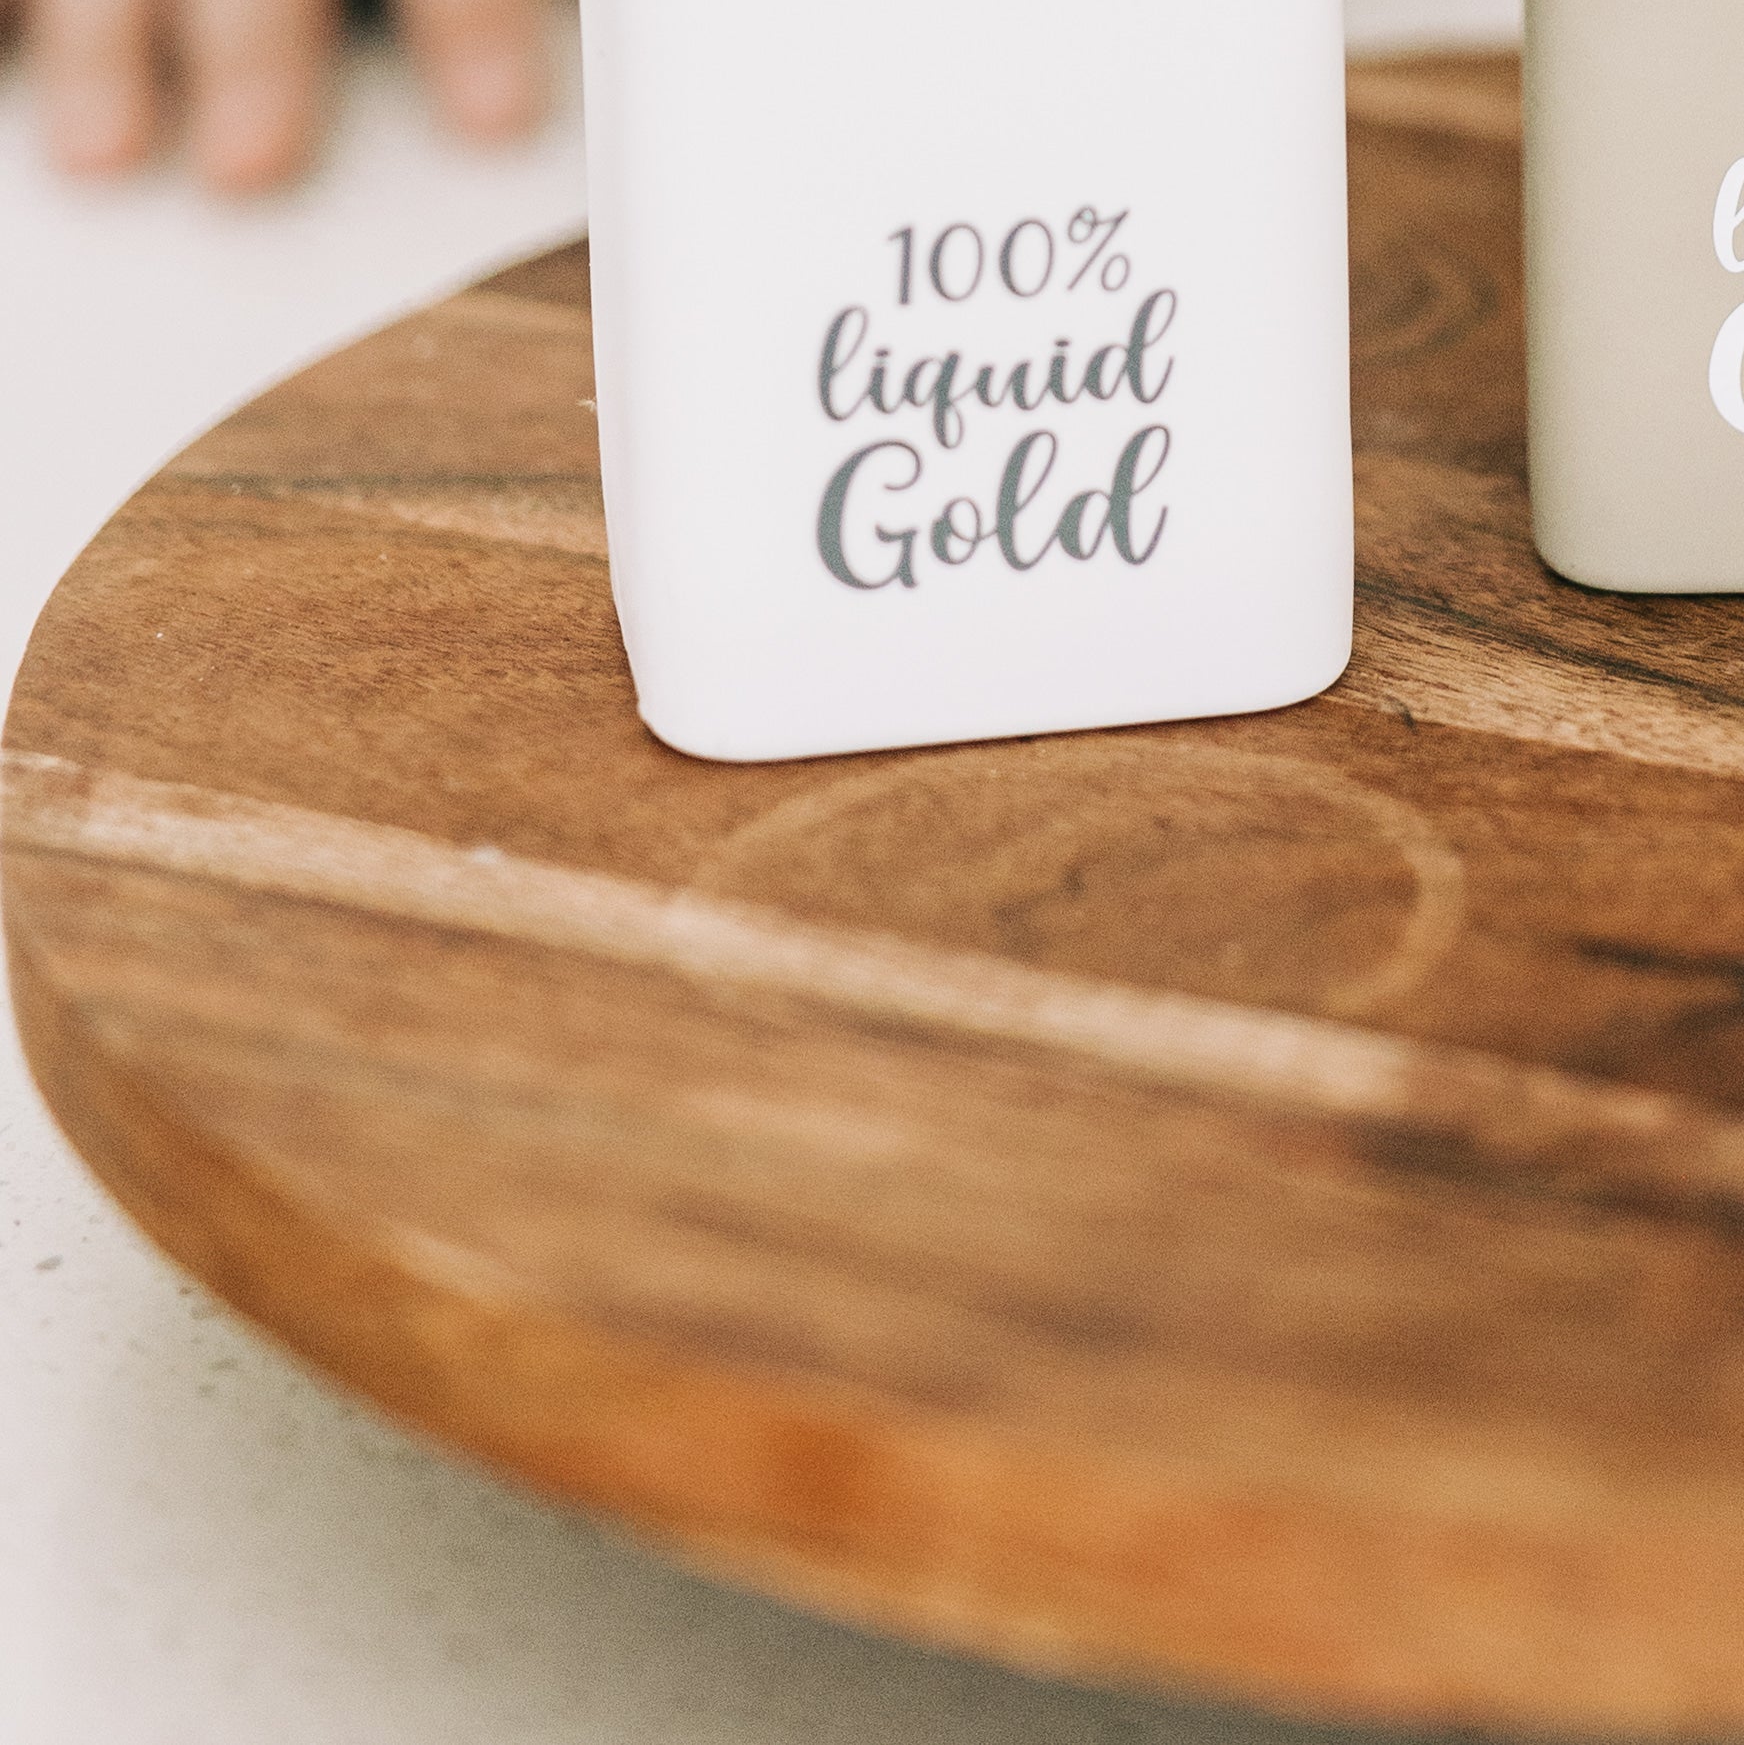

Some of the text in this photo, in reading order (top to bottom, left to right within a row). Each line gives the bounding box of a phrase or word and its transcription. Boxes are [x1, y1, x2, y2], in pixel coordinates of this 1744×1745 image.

[887, 204, 1131, 306] 100%
[818, 288, 1177, 449] liquid
[816, 424, 1171, 590] Gold
